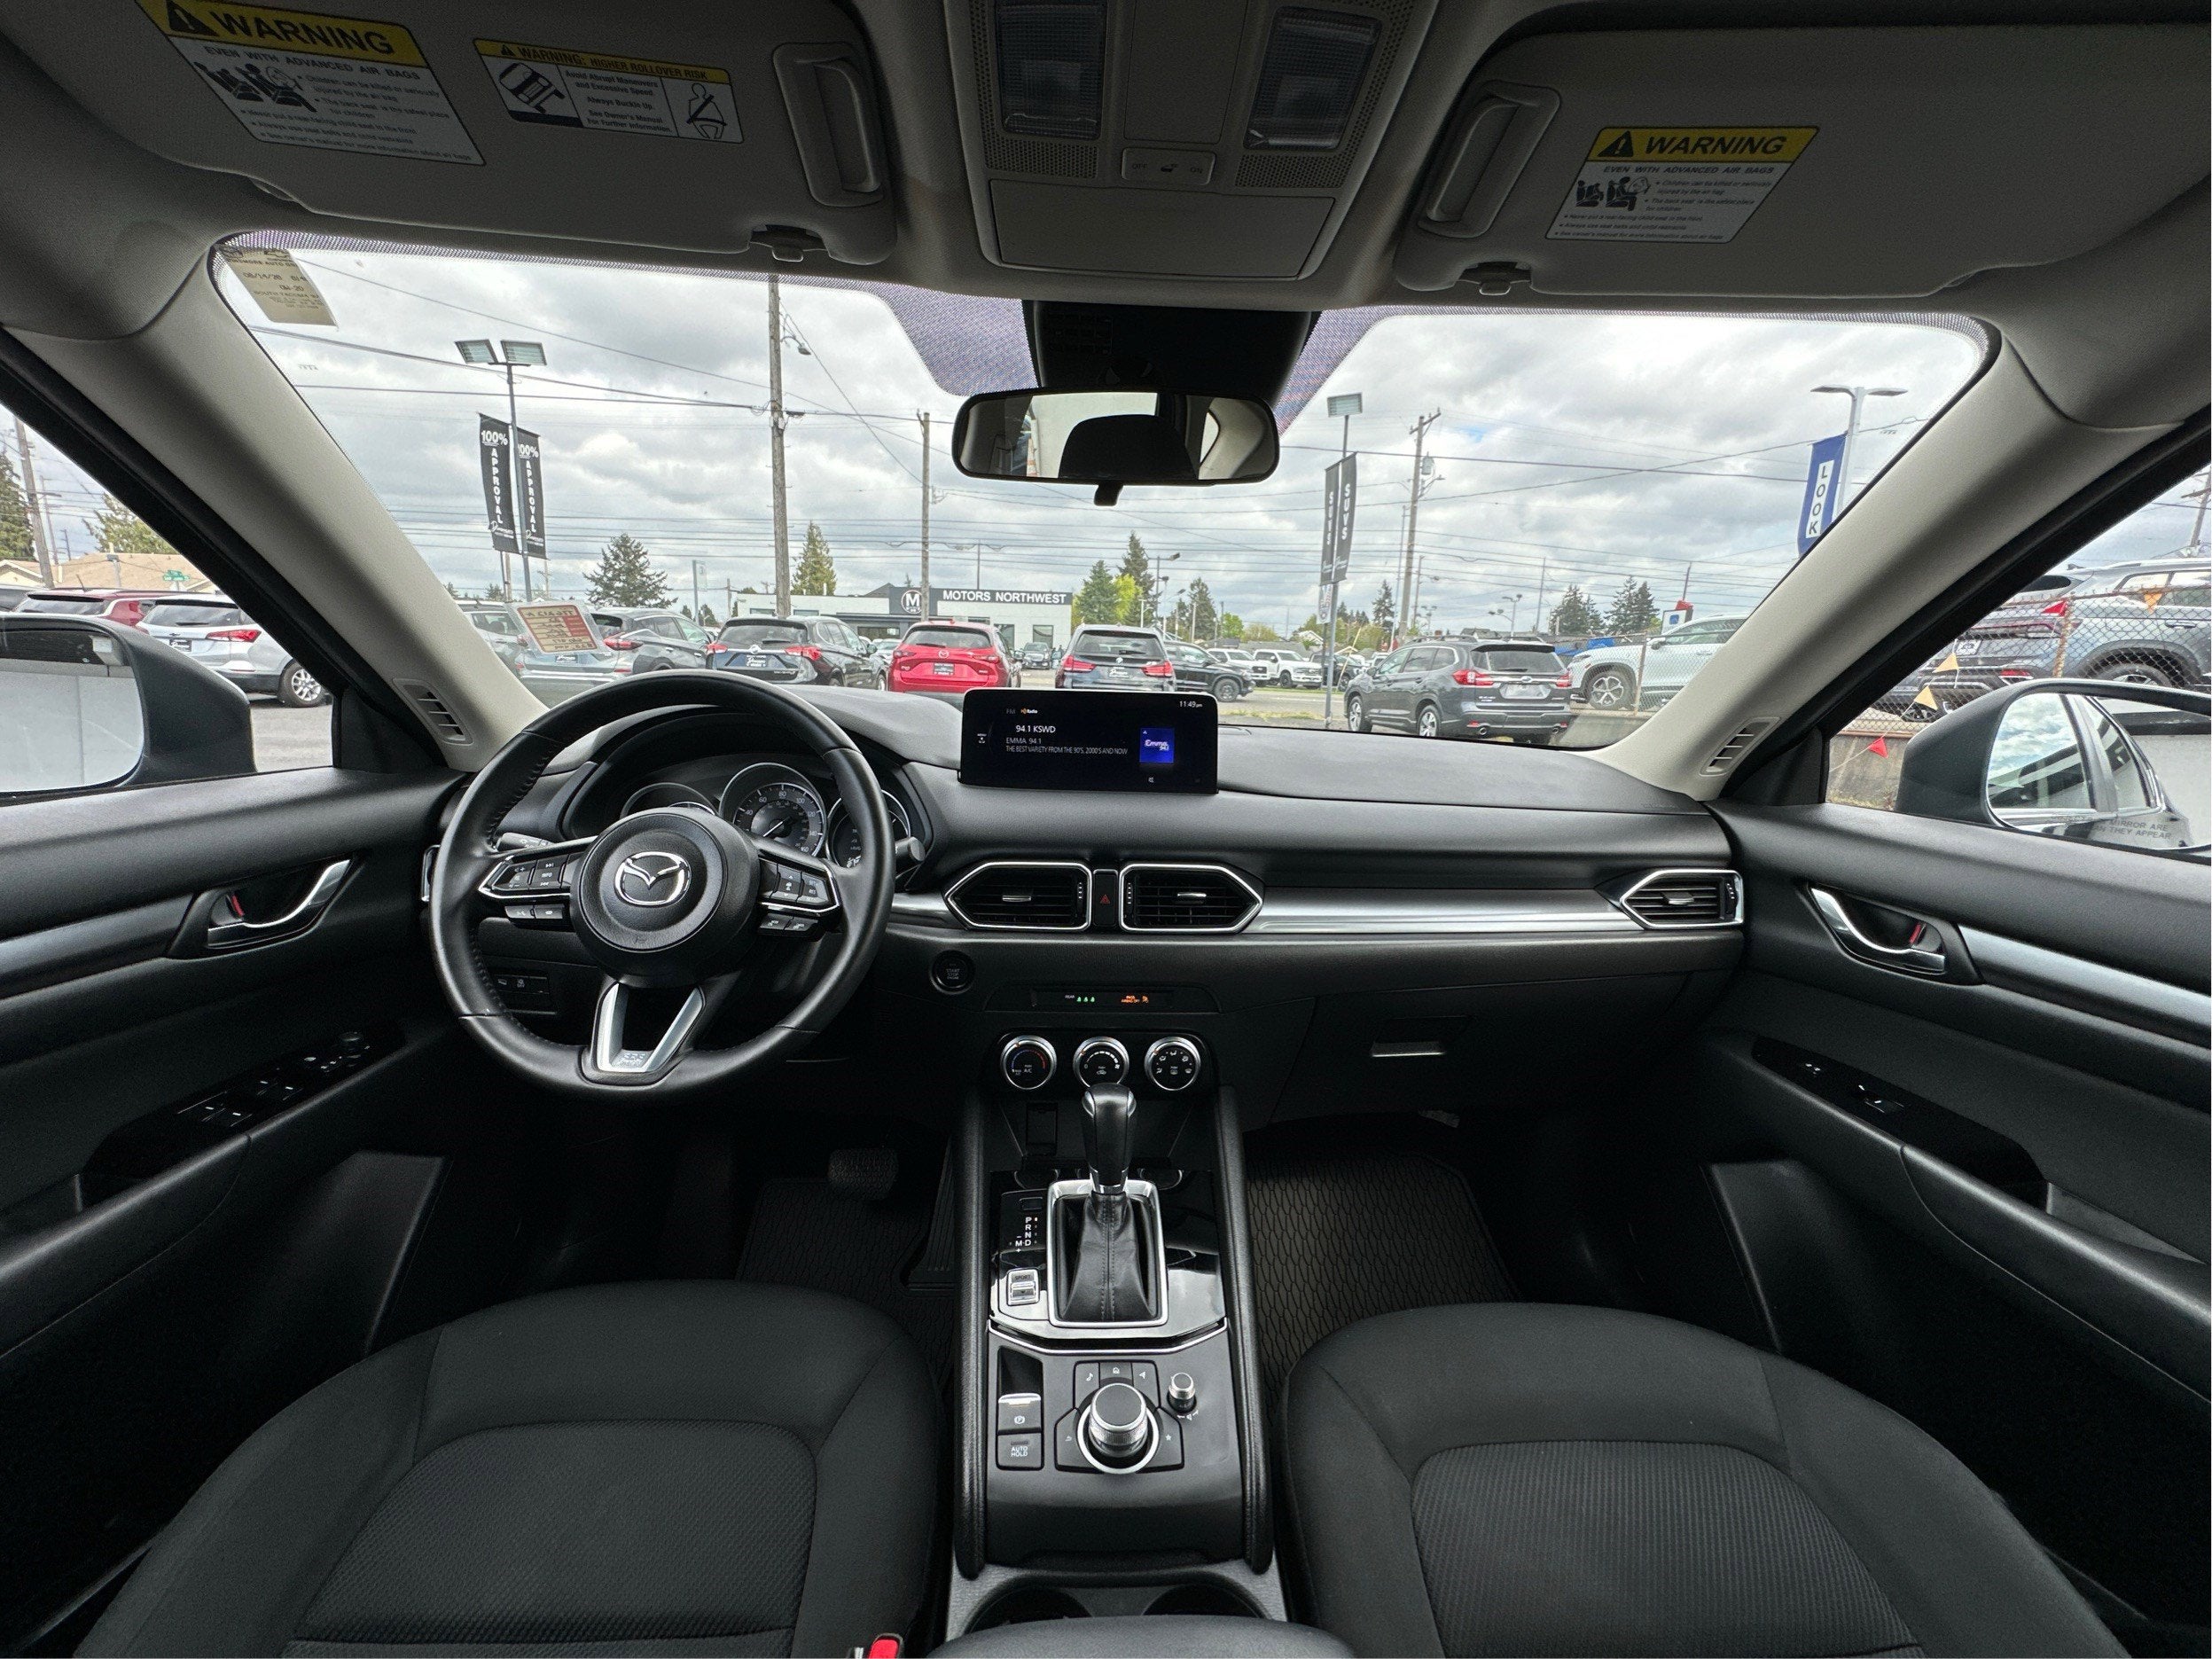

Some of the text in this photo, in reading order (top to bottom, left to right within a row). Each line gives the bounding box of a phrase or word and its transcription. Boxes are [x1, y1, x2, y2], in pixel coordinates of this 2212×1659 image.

[209, 11, 395, 55] WARNING
[201, 44, 421, 81] EVEN WITH ADVANCED AIR BAGS
[517, 47, 707, 80] WARNING: HIGHER ROLLOVER RISK
[1645, 135, 1788, 155] WARNING
[481, 430, 508, 446] 100%
[491, 448, 504, 525] APPROVAL
[526, 460, 536, 533] APPROVAL
[1809, 465, 1828, 535] LOOK
[905, 593, 920, 606] M
[942, 590, 1067, 604] MOTORS NORTHWEST
[2110, 826, 2133, 835] THEY
[2135, 830, 2172, 840] APPEAR
